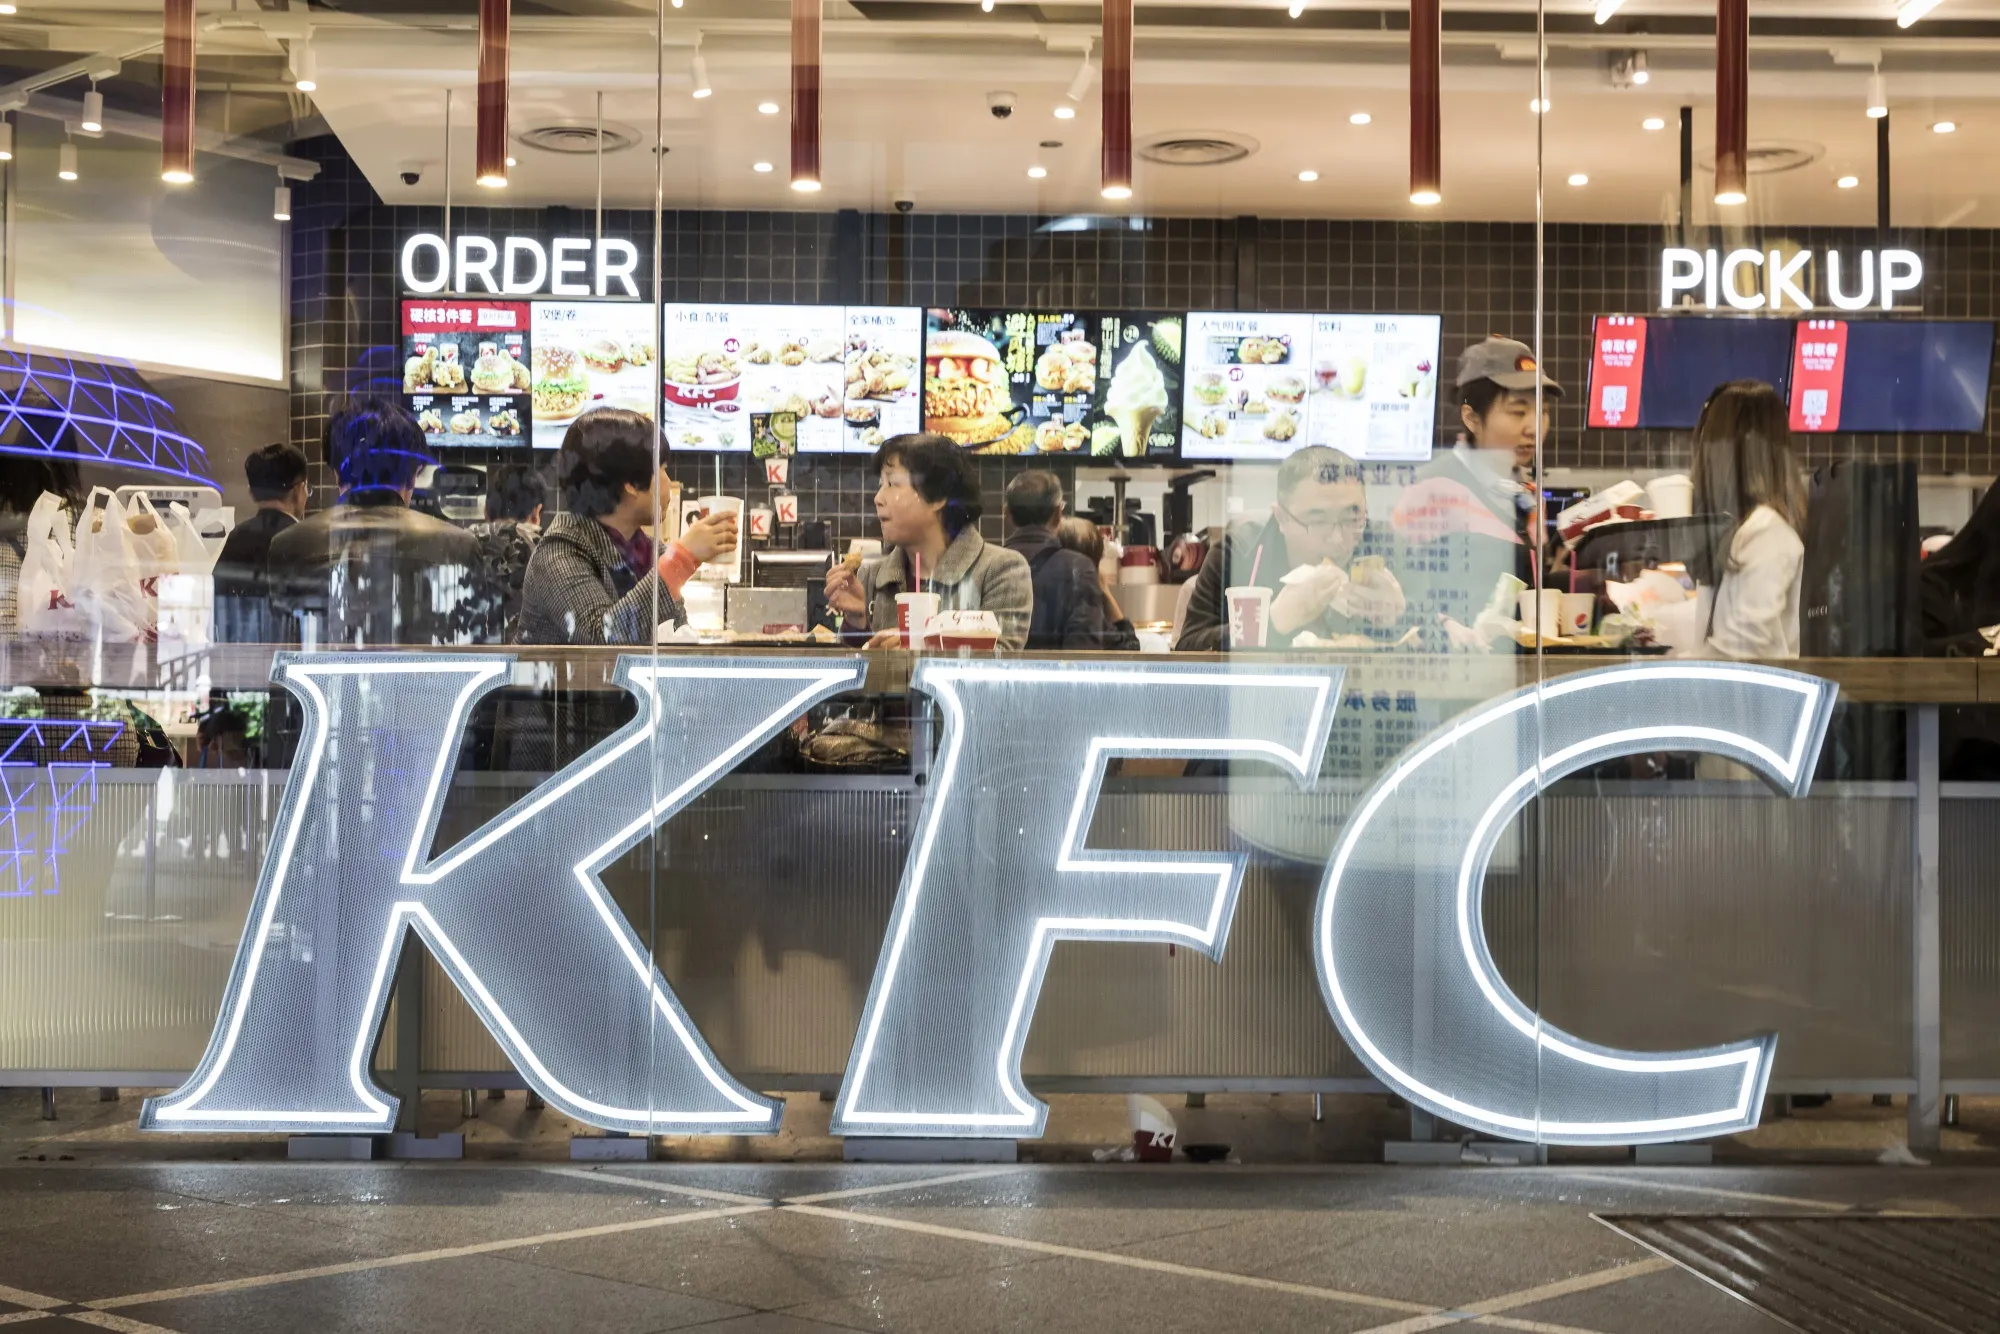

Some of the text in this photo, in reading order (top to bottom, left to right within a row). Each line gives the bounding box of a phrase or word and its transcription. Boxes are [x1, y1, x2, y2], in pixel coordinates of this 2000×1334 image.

[401, 233, 640, 297] ORDER
[1660, 248, 1923, 311] PICK UP
[539, 308, 577, 322] 汉堡/卷
[1199, 319, 1259, 332] 人气明星餐
[1318, 320, 1342, 332] 饮料
[1374, 321, 1398, 333] 甜点
[1601, 339, 1637, 354] 请取餐
[1801, 342, 1838, 357] 请取餐
[677, 386, 716, 399] KFC
[768, 464, 783, 483] K
[779, 502, 794, 521] K
[751, 515, 764, 533] K
[1807, 605, 1828, 618] GUCCI
[140, 650, 1839, 1145] KFC
